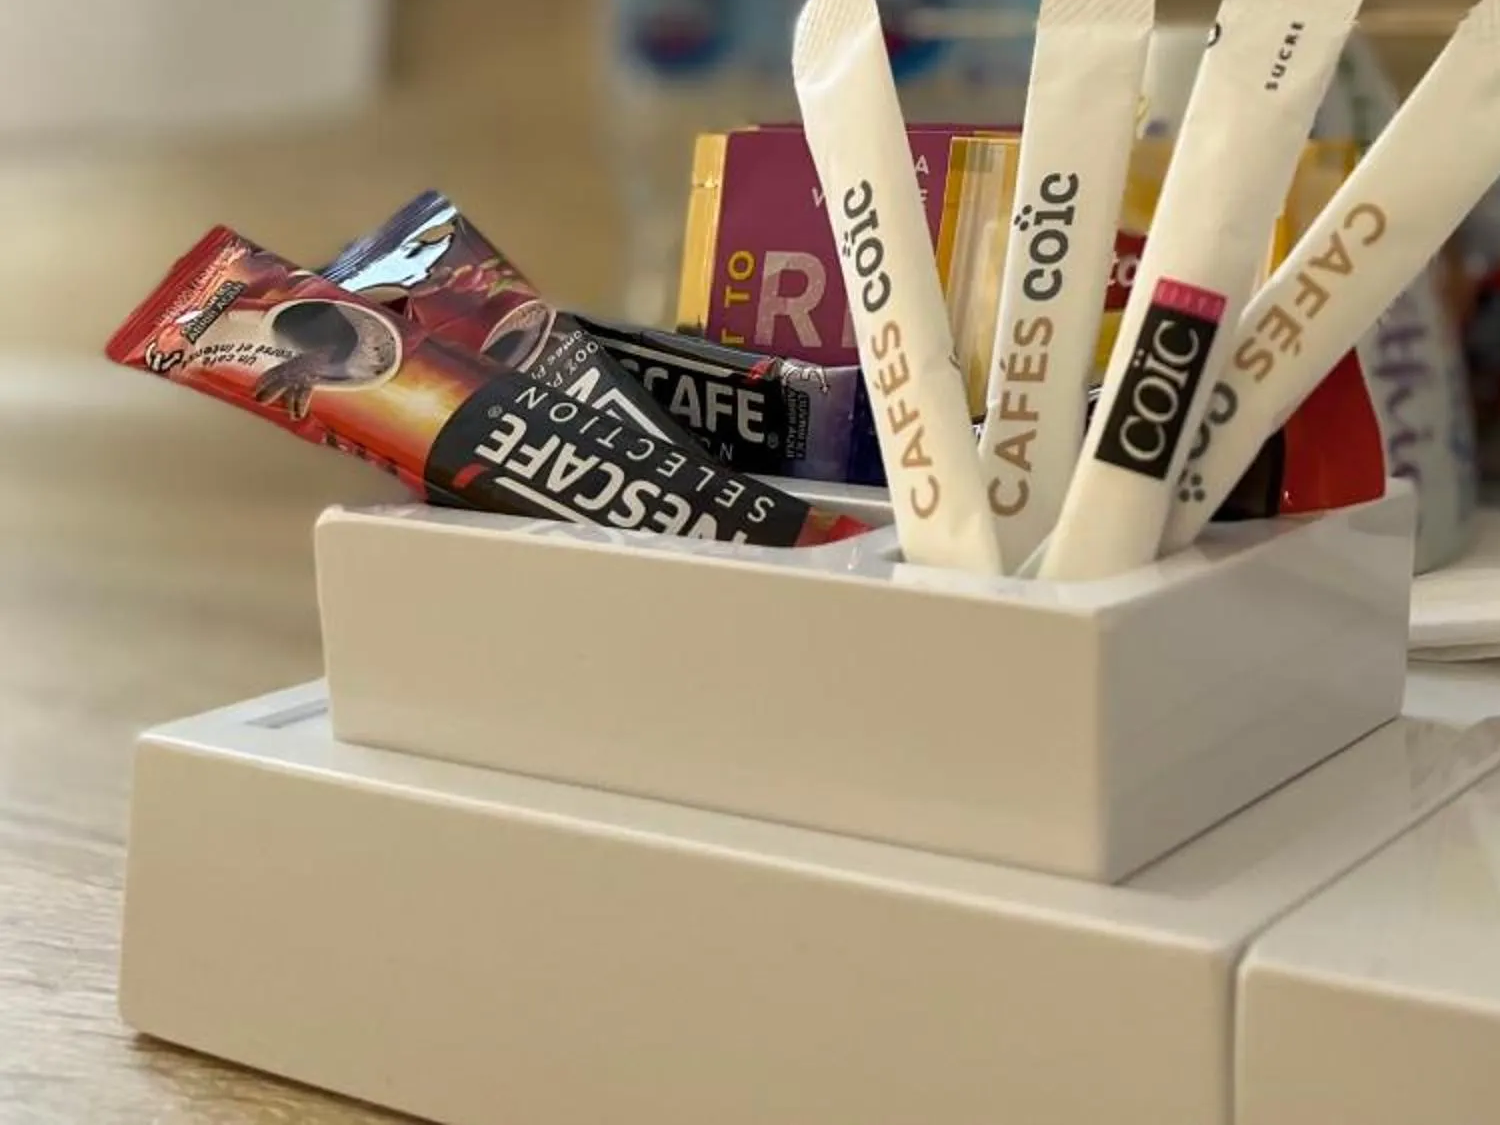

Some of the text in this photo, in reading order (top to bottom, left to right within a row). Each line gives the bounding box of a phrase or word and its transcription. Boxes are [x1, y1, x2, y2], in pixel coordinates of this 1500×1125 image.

[1264, 21, 1305, 91] SUCRE
[1233, 201, 1388, 382] CAFÉS
[514, 385, 777, 524] SELECTION
[872, 320, 941, 519] CAFÉS
[986, 315, 1055, 517] CAFÉS
[1118, 319, 1200, 463] COÏC
